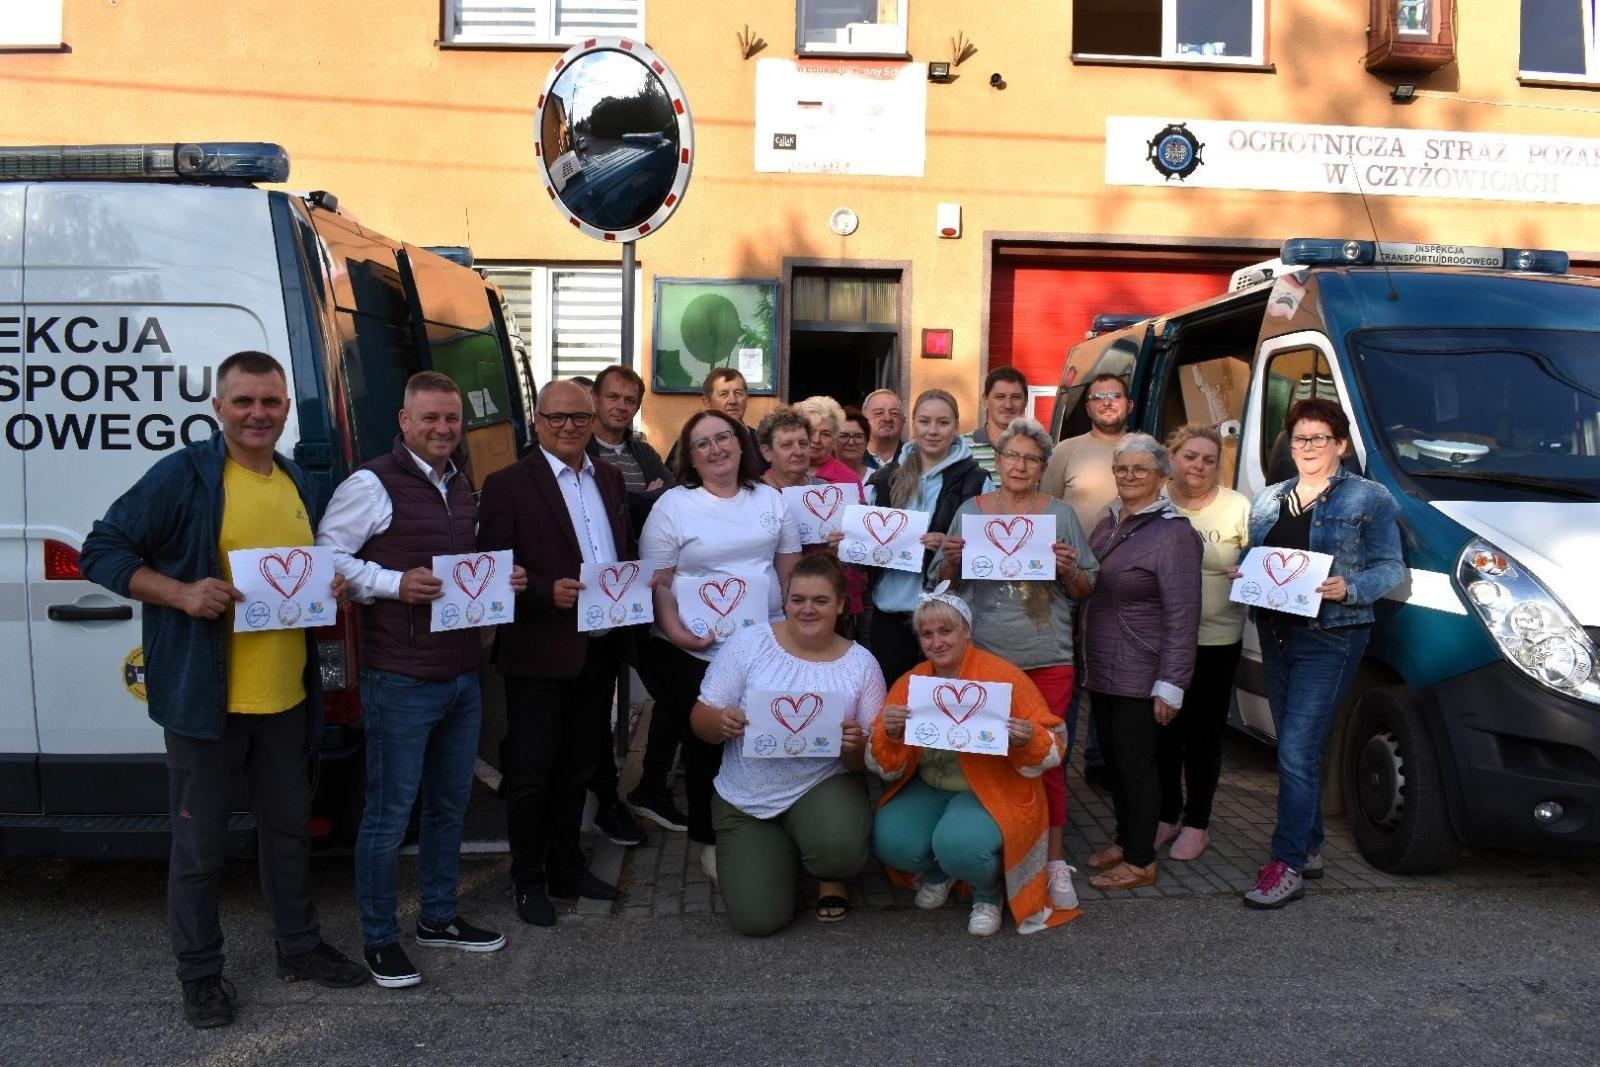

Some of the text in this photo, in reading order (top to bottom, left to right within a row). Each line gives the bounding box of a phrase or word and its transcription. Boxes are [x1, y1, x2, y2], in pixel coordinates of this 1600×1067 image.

[1228, 129, 1406, 157] OCHOTNICZA
[1425, 138, 1508, 162] STRAŻ
[1323, 162, 1560, 193] W CZYŻOWICACH
[1380, 253, 1499, 266] TRANSPORTU DROGOWEGO
[1415, 245, 1464, 255] INSPEKCJA
[5, 413, 220, 451] OWEGO
